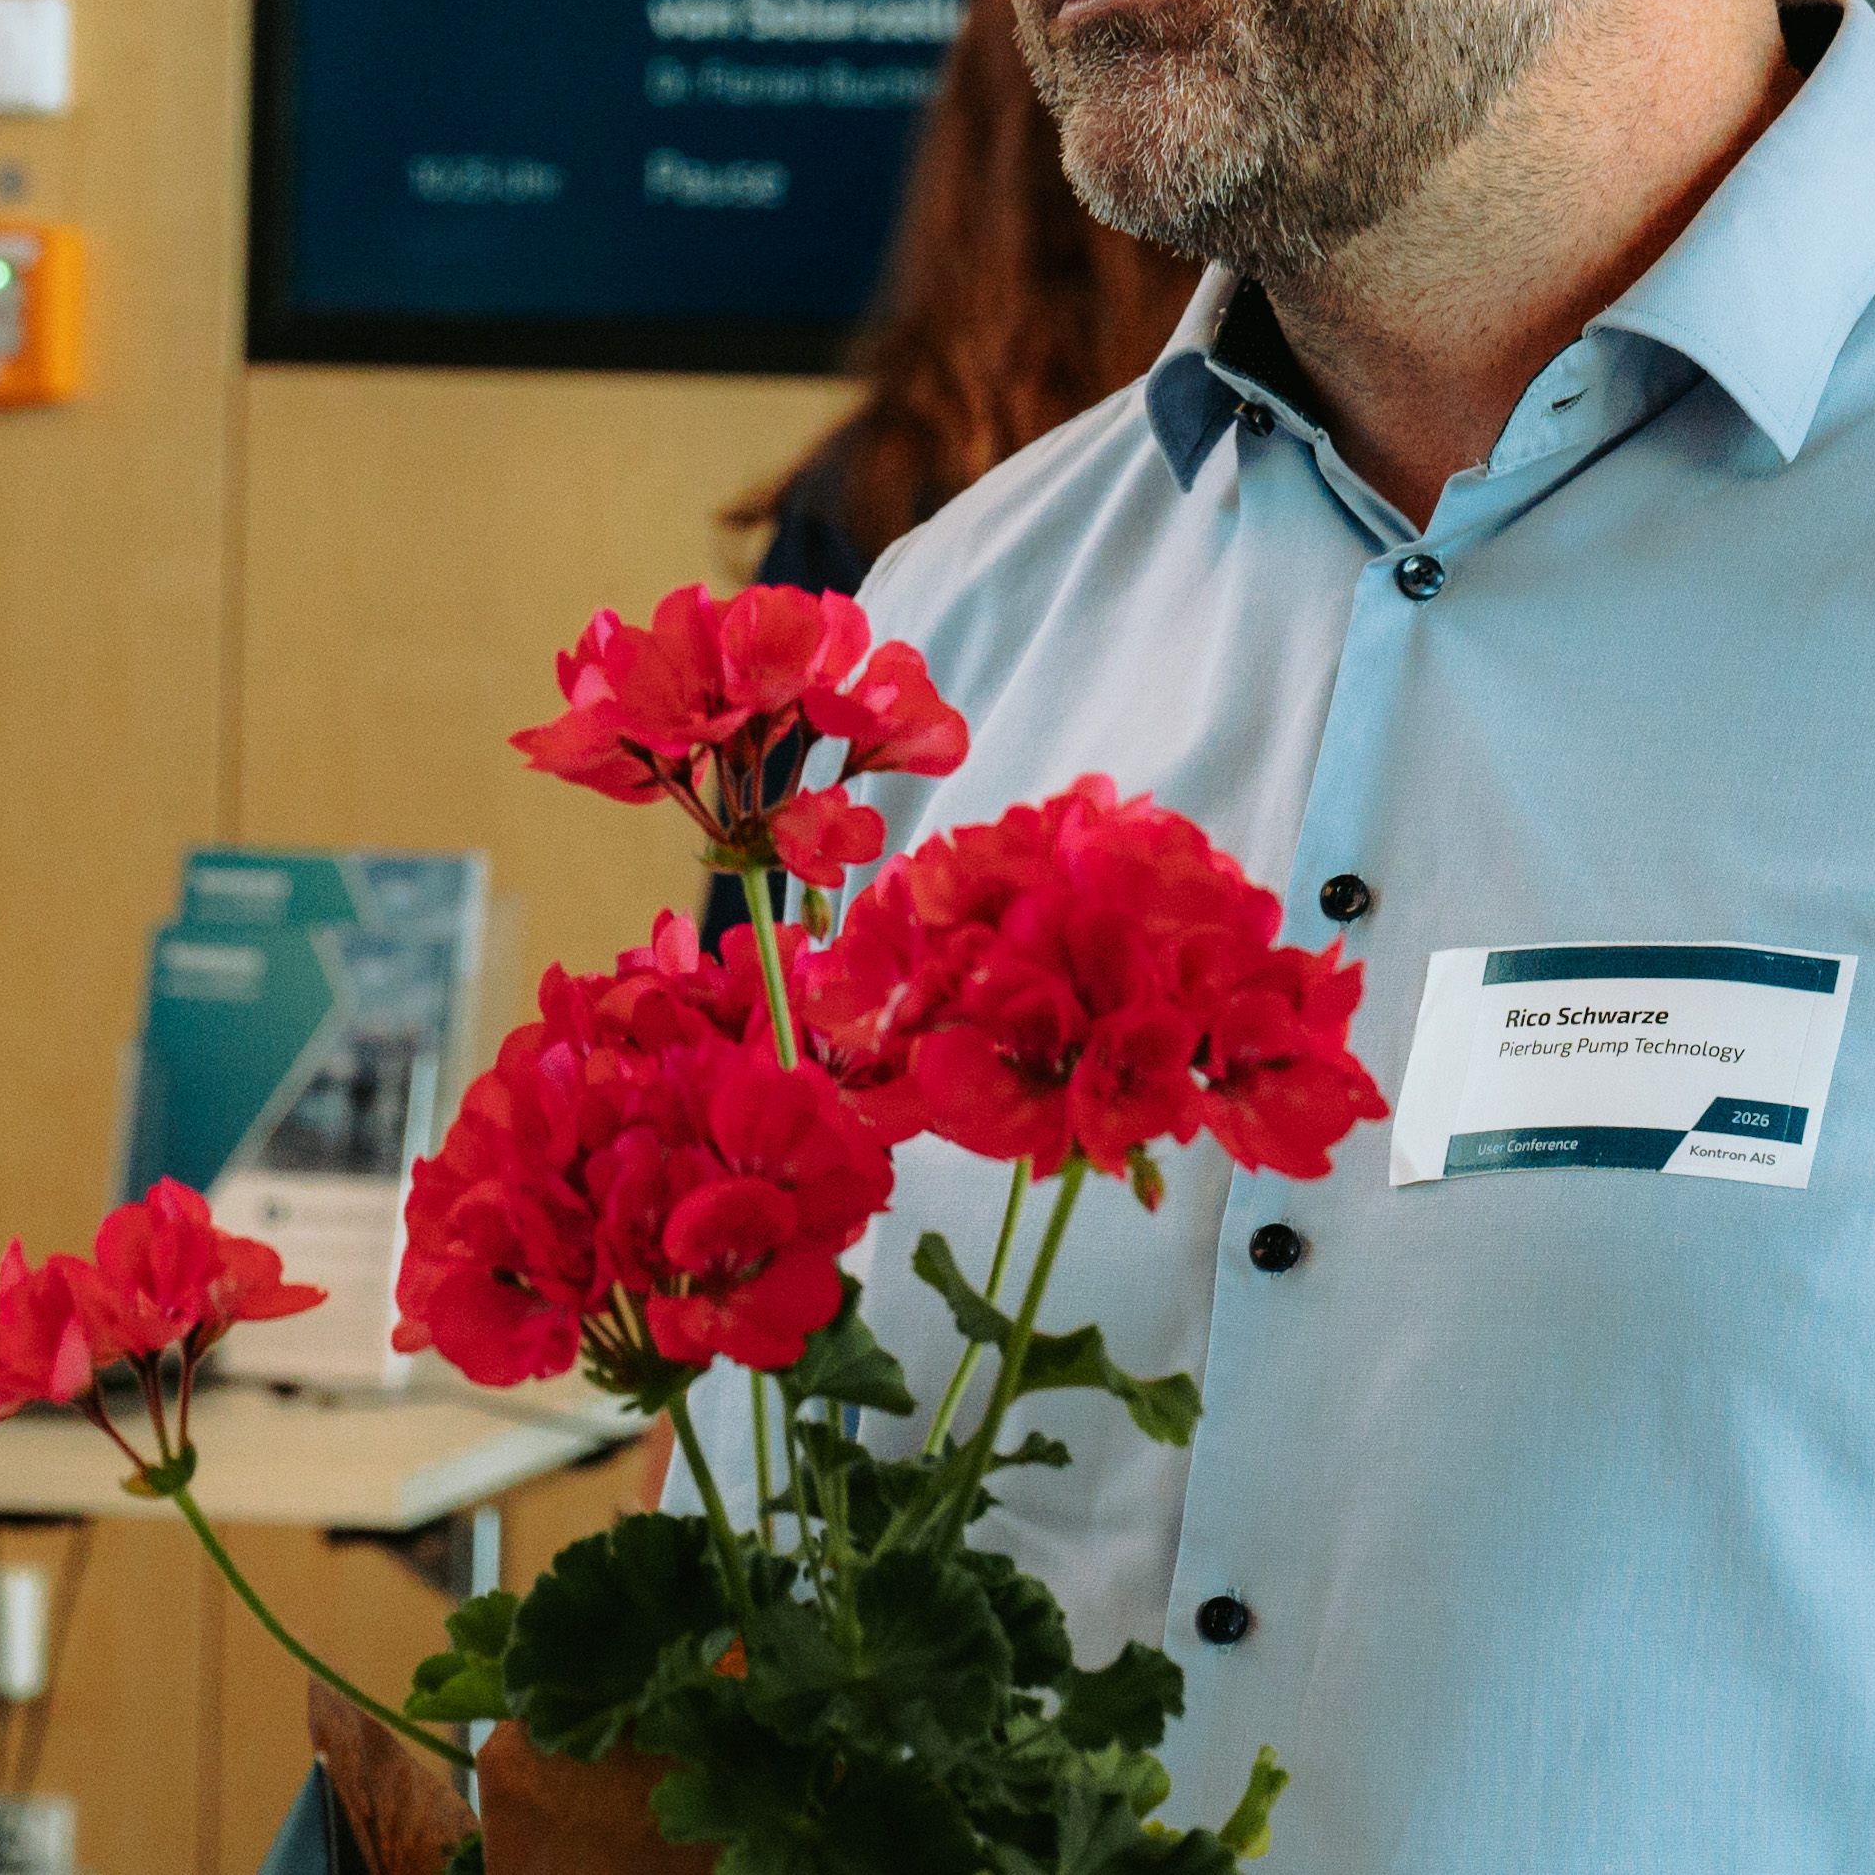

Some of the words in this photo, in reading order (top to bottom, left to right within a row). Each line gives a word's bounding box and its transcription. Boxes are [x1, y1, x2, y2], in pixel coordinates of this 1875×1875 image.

[645, 148, 788, 207] Pause
[1505, 1009, 1551, 1028] Rico
[1556, 1006, 1669, 1026] Schwarze
[1499, 1040, 1573, 1058] Pierburg
[1576, 1037, 1629, 1057] Pump
[1635, 1037, 1746, 1063] Technology
[1731, 1110, 1771, 1128] 2026
[1477, 1141, 1506, 1157] User
[1507, 1138, 1579, 1154] Conference
[1689, 1145, 1747, 1162] Kontron
[1749, 1151, 1777, 1166] AIS
